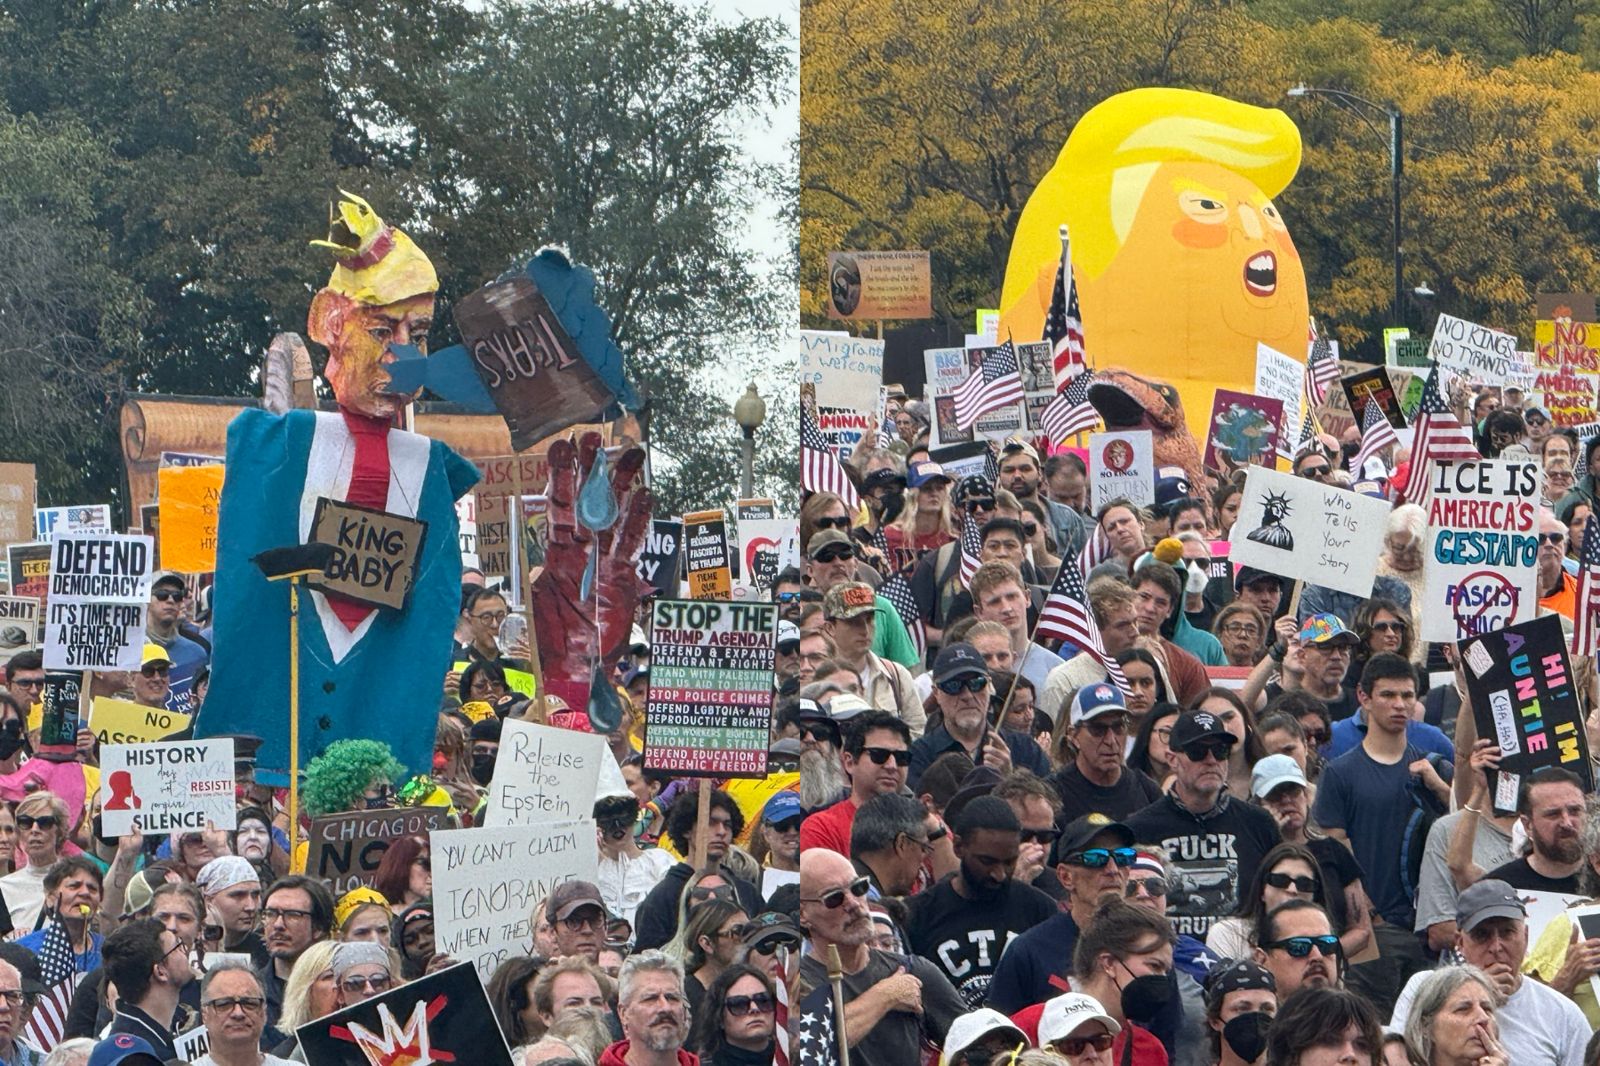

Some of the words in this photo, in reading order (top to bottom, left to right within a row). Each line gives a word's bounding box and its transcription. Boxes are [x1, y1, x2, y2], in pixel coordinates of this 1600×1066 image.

[1438, 317, 1465, 341] NO
[1470, 324, 1517, 359] KINGS
[1554, 321, 1587, 346] NO
[1274, 358, 1294, 374] HAVE
[1433, 340, 1453, 358] NO
[1460, 345, 1511, 377] TYRANTS
[1537, 343, 1599, 372] KINGS
[1260, 376, 1275, 390] BUT
[1266, 366, 1278, 378] NO
[1434, 460, 1493, 494] ICE
[1503, 463, 1538, 497] IS
[1324, 491, 1352, 510] Who
[38, 511, 59, 534] IF
[1325, 512, 1358, 532] Tells
[1429, 496, 1534, 532] AMERICA'S
[338, 516, 404, 556] KING
[1323, 531, 1350, 548] Your
[56, 539, 147, 577] DEFEND
[1434, 529, 1539, 568] GESTAPO
[324, 548, 404, 592] BABY
[1318, 553, 1349, 574] Story
[53, 575, 145, 597] DEMOCRACY:
[1445, 584, 1522, 606] FASCIST
[51, 603, 77, 625] IT'S
[80, 604, 111, 626] TIME
[113, 605, 141, 627] FOR
[656, 602, 722, 630] STOP
[729, 606, 775, 632] THE
[58, 624, 67, 645] A
[70, 624, 129, 646] GENERAL
[655, 629, 704, 645] TRUMP
[708, 631, 774, 649] AGENDA!
[66, 645, 119, 667] STRIKE!
[652, 655, 723, 668] IMMIGRANT
[730, 658, 775, 670] RIGHTS
[653, 645, 702, 656] DEFEND
[709, 648, 718, 659] &
[725, 648, 775, 660] EXPAND
[651, 677, 672, 688] END
[676, 678, 690, 688] US
[695, 680, 713, 690] AID
[718, 682, 731, 691] TO
[735, 682, 771, 692] ISRAEL
[652, 667, 686, 678] STAND
[690, 669, 715, 680] WITH
[719, 670, 773, 682] PALESTINE
[649, 689, 680, 700] STOP
[685, 691, 725, 703] POLICE
[730, 693, 770, 704] CRIMES
[1503, 631, 1548, 754] AUNTIE
[145, 711, 171, 729] NO
[648, 702, 690, 714] DEFEND
[694, 705, 746, 717] LGBTQIA+
[748, 707, 770, 718] AND
[647, 714, 728, 727] REPRODUCTIVE
[732, 717, 769, 729] RIGHTS
[647, 726, 680, 736] DEFEND
[727, 729, 754, 739] RIGHTS
[757, 731, 767, 739] TO
[510, 731, 584, 769] Release
[646, 735, 704, 748] UNIONIZE
[727, 740, 768, 751] STRIKE
[126, 746, 208, 766] HISTORY
[644, 757, 707, 770] ACADEMIC
[712, 760, 766, 773] FREEDOM
[646, 747, 688, 759] DEFEND
[692, 751, 754, 762] EDUCATION
[191, 780, 232, 792] RESIST!
[528, 763, 560, 787] the
[502, 784, 570, 819] Epstein
[133, 811, 205, 830] SILENCE
[322, 815, 439, 841] CHICAGO'S
[443, 845, 466, 871] YOU
[528, 832, 577, 857] CLAIM
[1162, 833, 1238, 861] FUCK
[442, 926, 491, 954] WHEN
